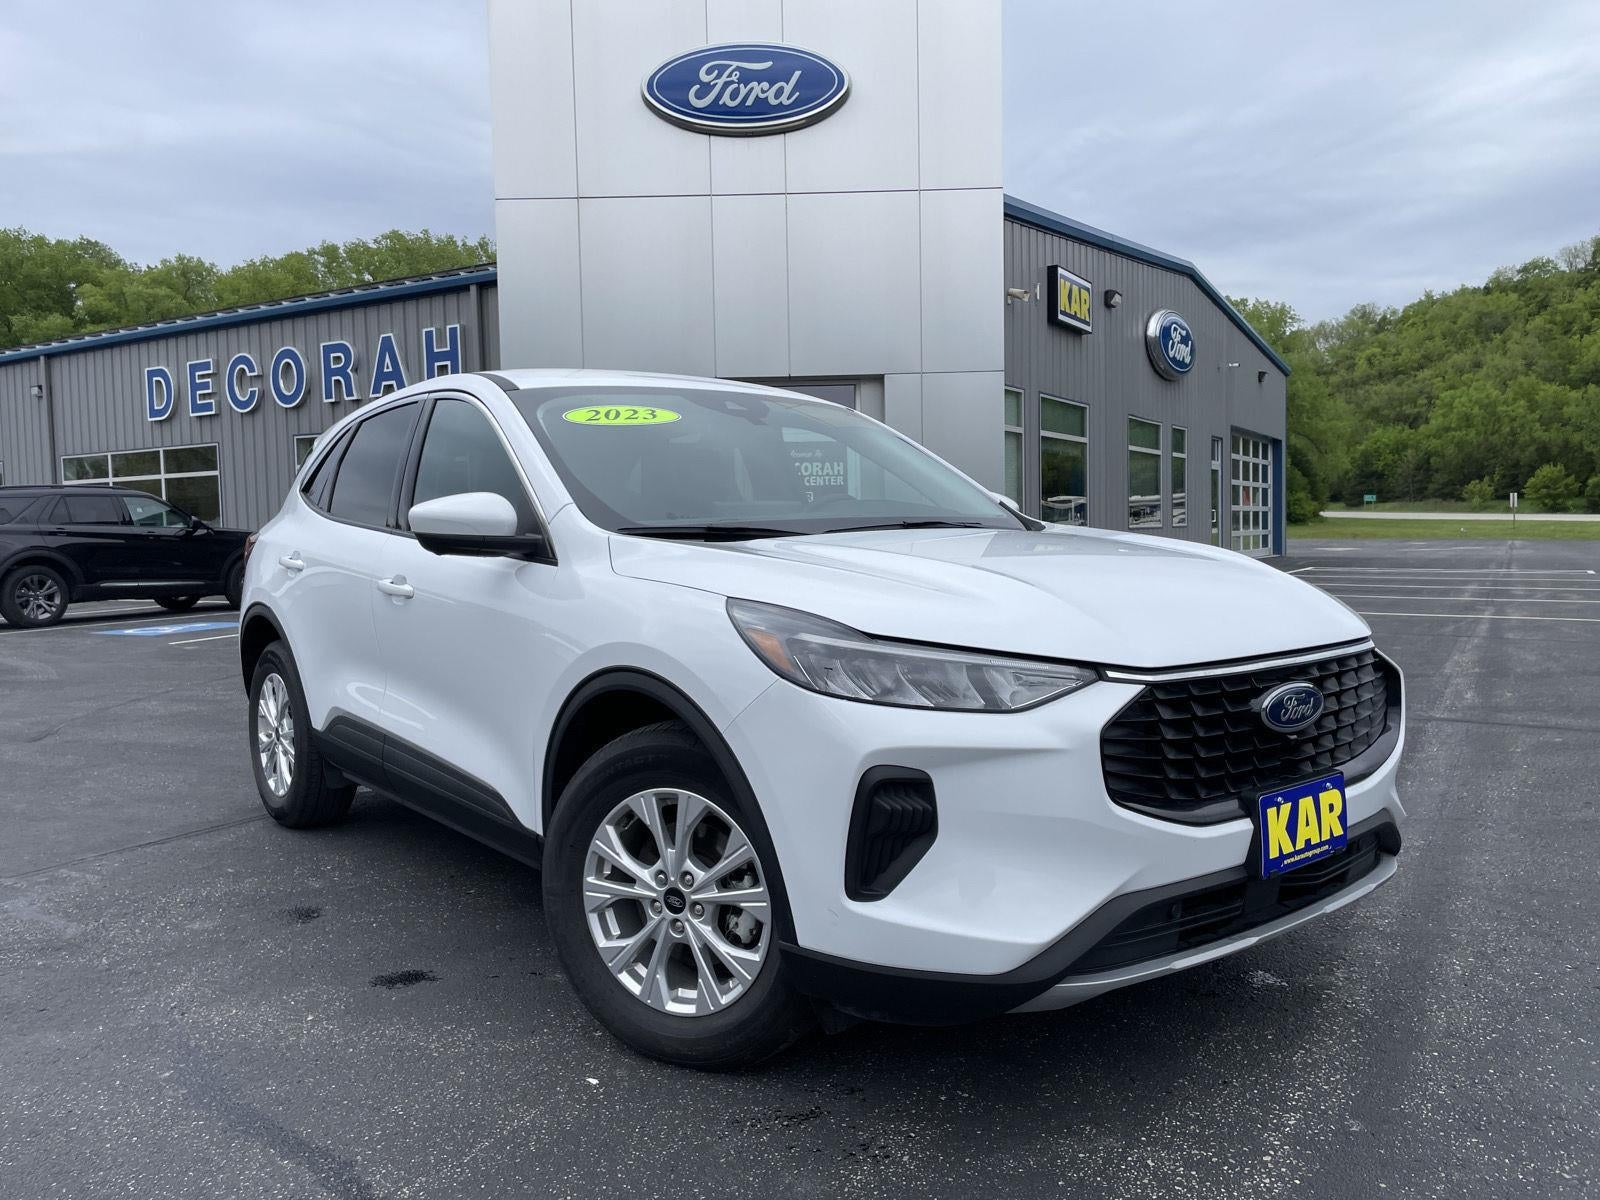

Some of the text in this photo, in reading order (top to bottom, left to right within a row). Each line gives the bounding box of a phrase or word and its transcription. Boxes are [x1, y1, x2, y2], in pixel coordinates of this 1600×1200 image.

[688, 60, 802, 109] Ford
[1060, 278, 1091, 322] KAR
[1169, 323, 1192, 365] Ford
[144, 323, 463, 422] DECORAH
[585, 408, 657, 422] 2023
[804, 476, 844, 486] CENTER
[1281, 692, 1313, 721] Ford
[1266, 788, 1344, 859] KAR
